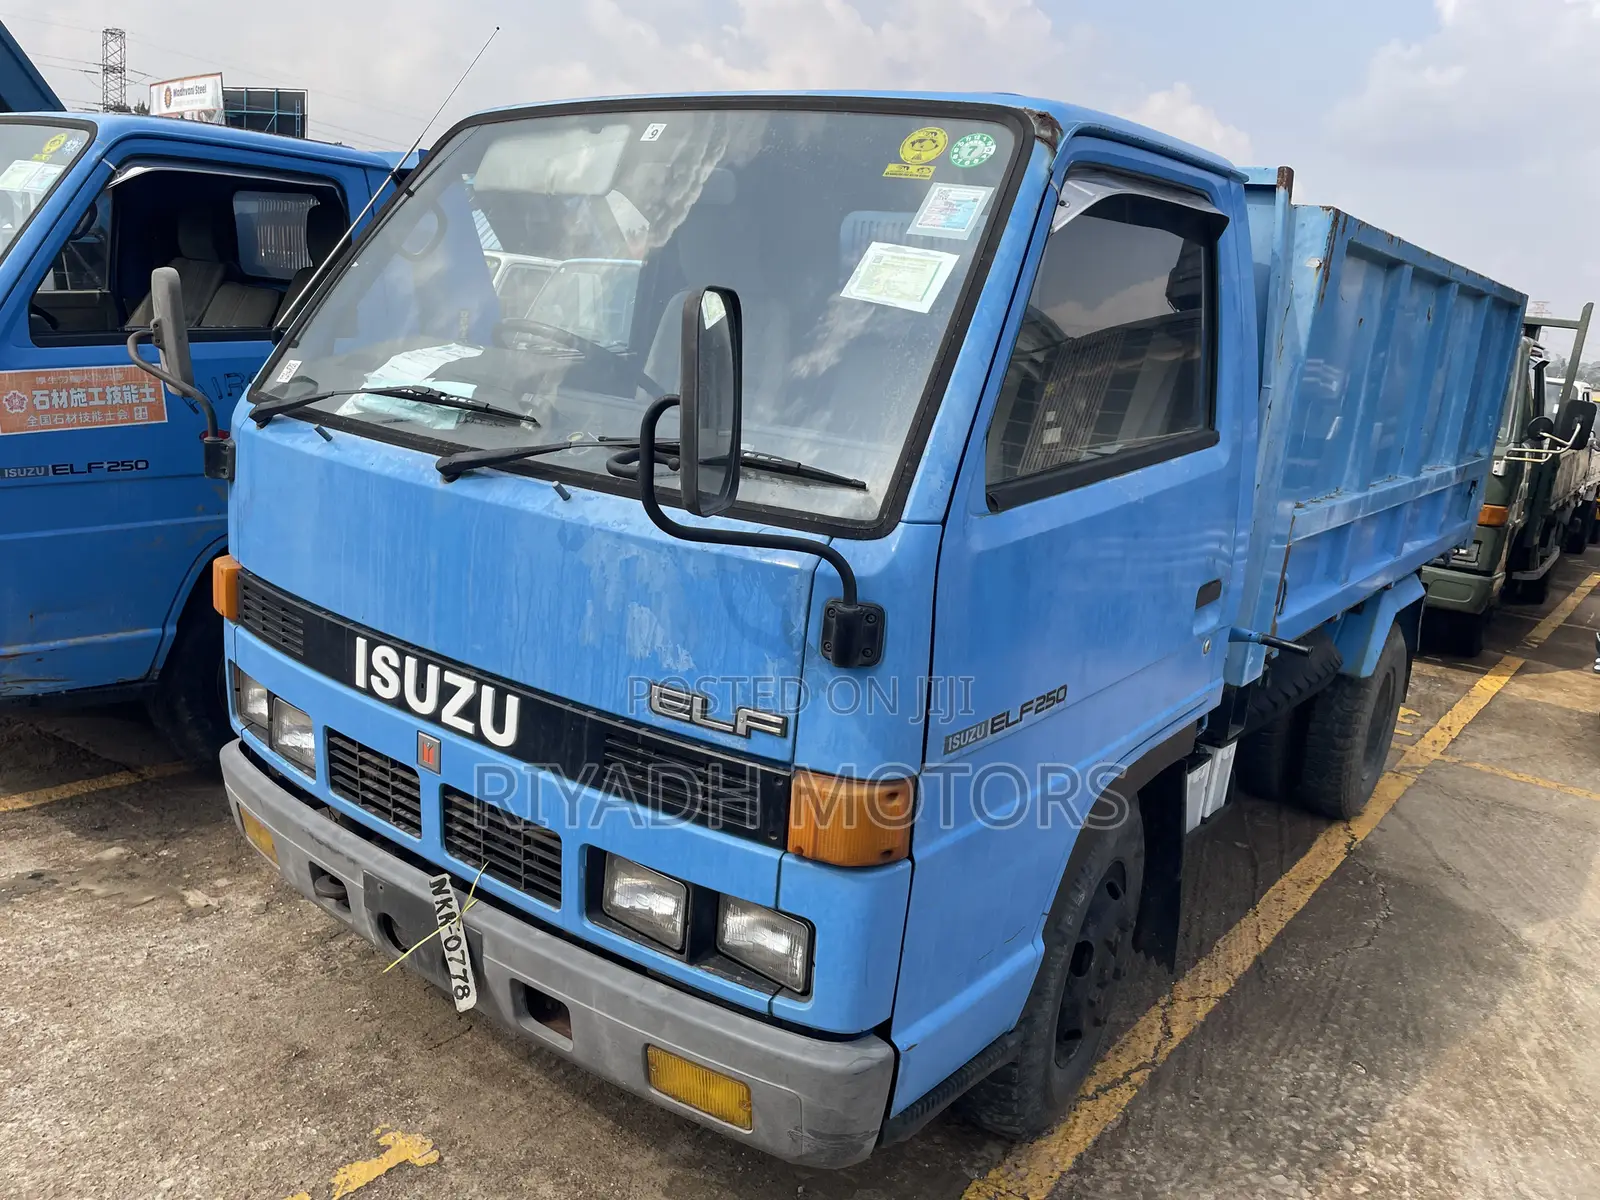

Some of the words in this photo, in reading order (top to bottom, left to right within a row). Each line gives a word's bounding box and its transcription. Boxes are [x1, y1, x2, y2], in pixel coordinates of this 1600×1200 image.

[195, 84, 207, 94] Steel
[649, 129, 659, 140] 9
[967, 145, 978, 157] 7
[31, 383, 156, 410] 石材施工技能士
[4, 467, 45, 478] ISUZU
[355, 636, 520, 747] ISUZU
[650, 682, 788, 739] ELF
[948, 722, 986, 751] ISUZU
